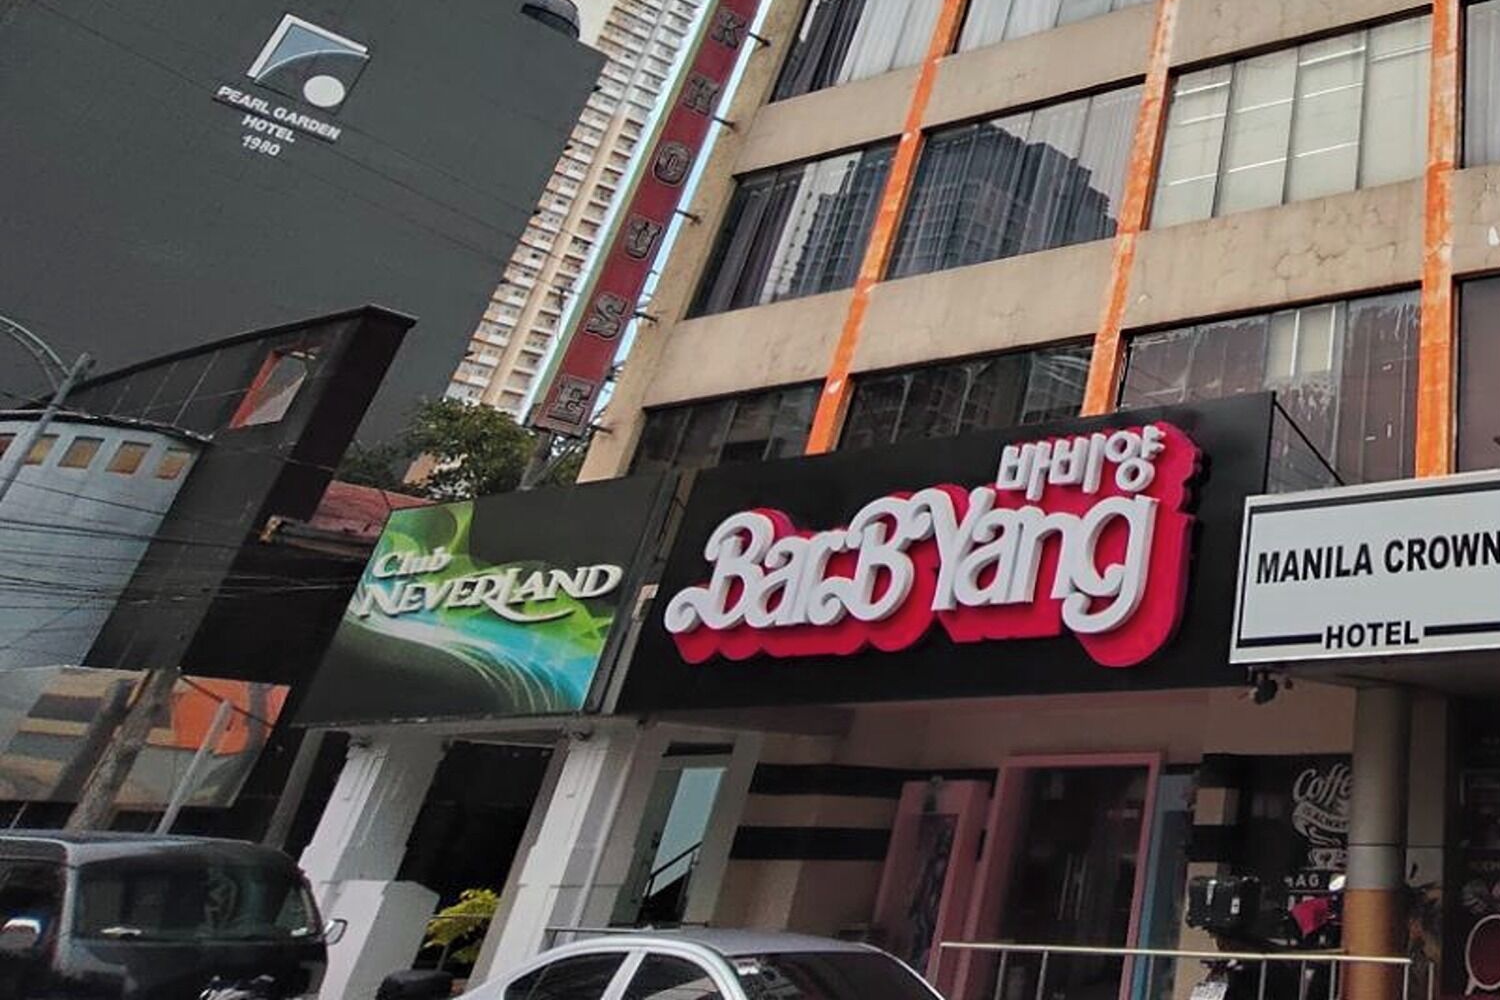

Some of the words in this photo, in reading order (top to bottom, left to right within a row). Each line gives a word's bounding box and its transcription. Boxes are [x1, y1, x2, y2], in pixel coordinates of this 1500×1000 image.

[217, 85, 270, 115] PEARL
[273, 107, 341, 140] GARDEN
[241, 114, 295, 143] HOTEL
[242, 134, 280, 157] 1980
[997, 425, 1165, 501] 바비양
[372, 546, 452, 577] Club
[1256, 543, 1374, 584] MANILA
[1325, 621, 1419, 649] HOTEL
[1293, 763, 1351, 807] Coffe
